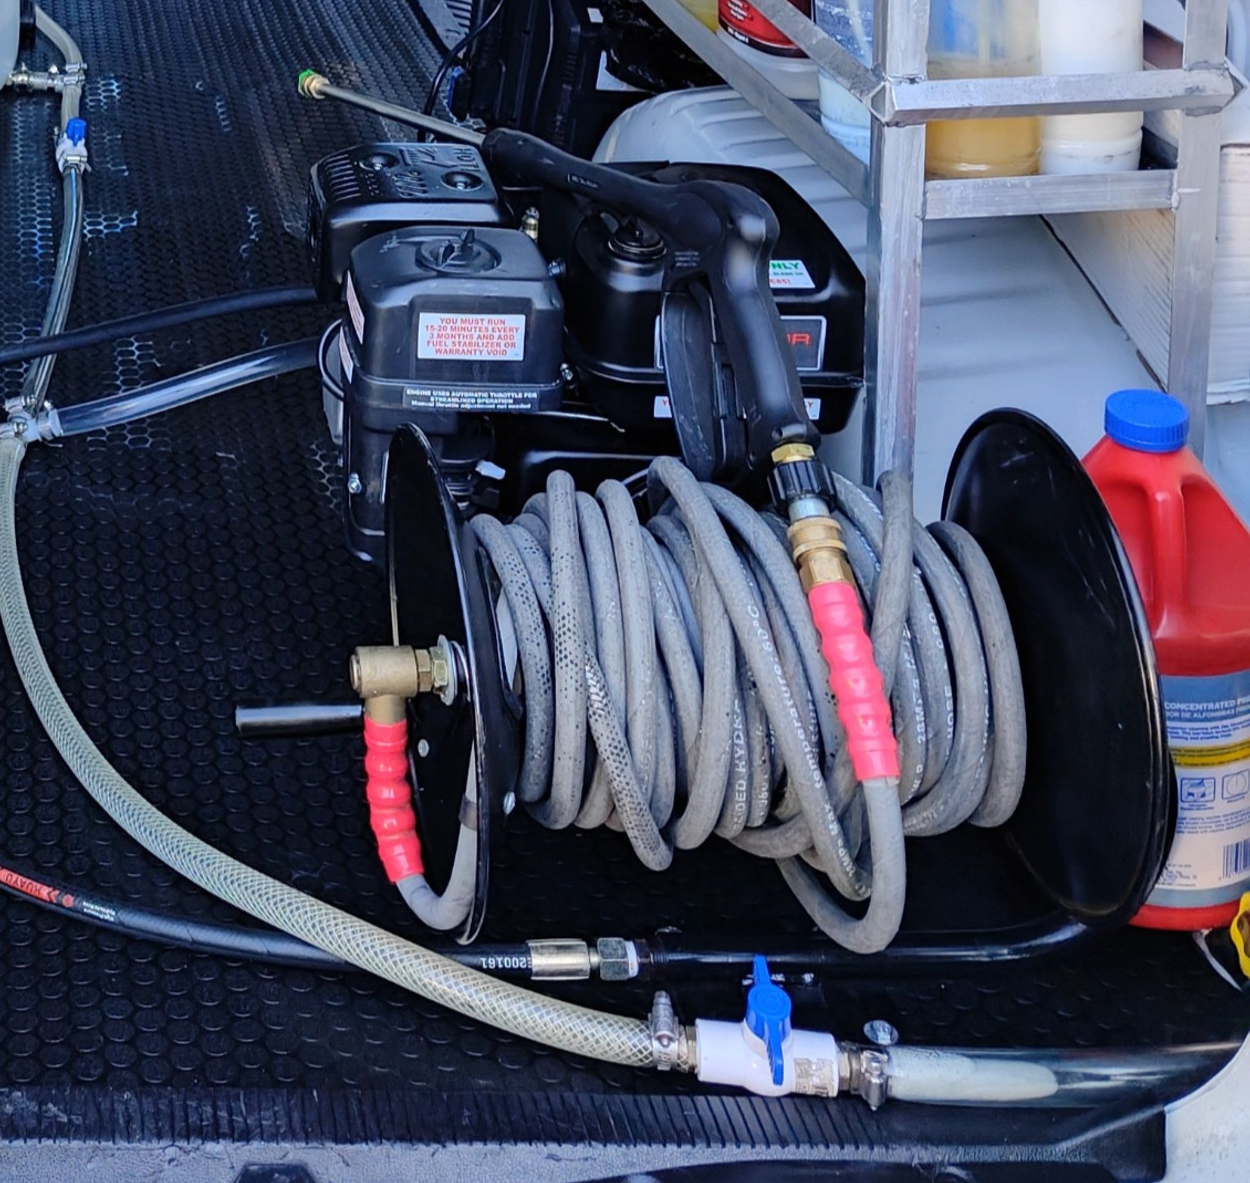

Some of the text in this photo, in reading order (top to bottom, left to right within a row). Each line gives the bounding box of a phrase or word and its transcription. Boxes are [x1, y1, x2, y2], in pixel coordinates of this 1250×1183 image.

[435, 348, 484, 356] WARRANTY
[1164, 699, 1236, 711] CONCENTRATED
[5, 872, 42, 895] HUAYU
